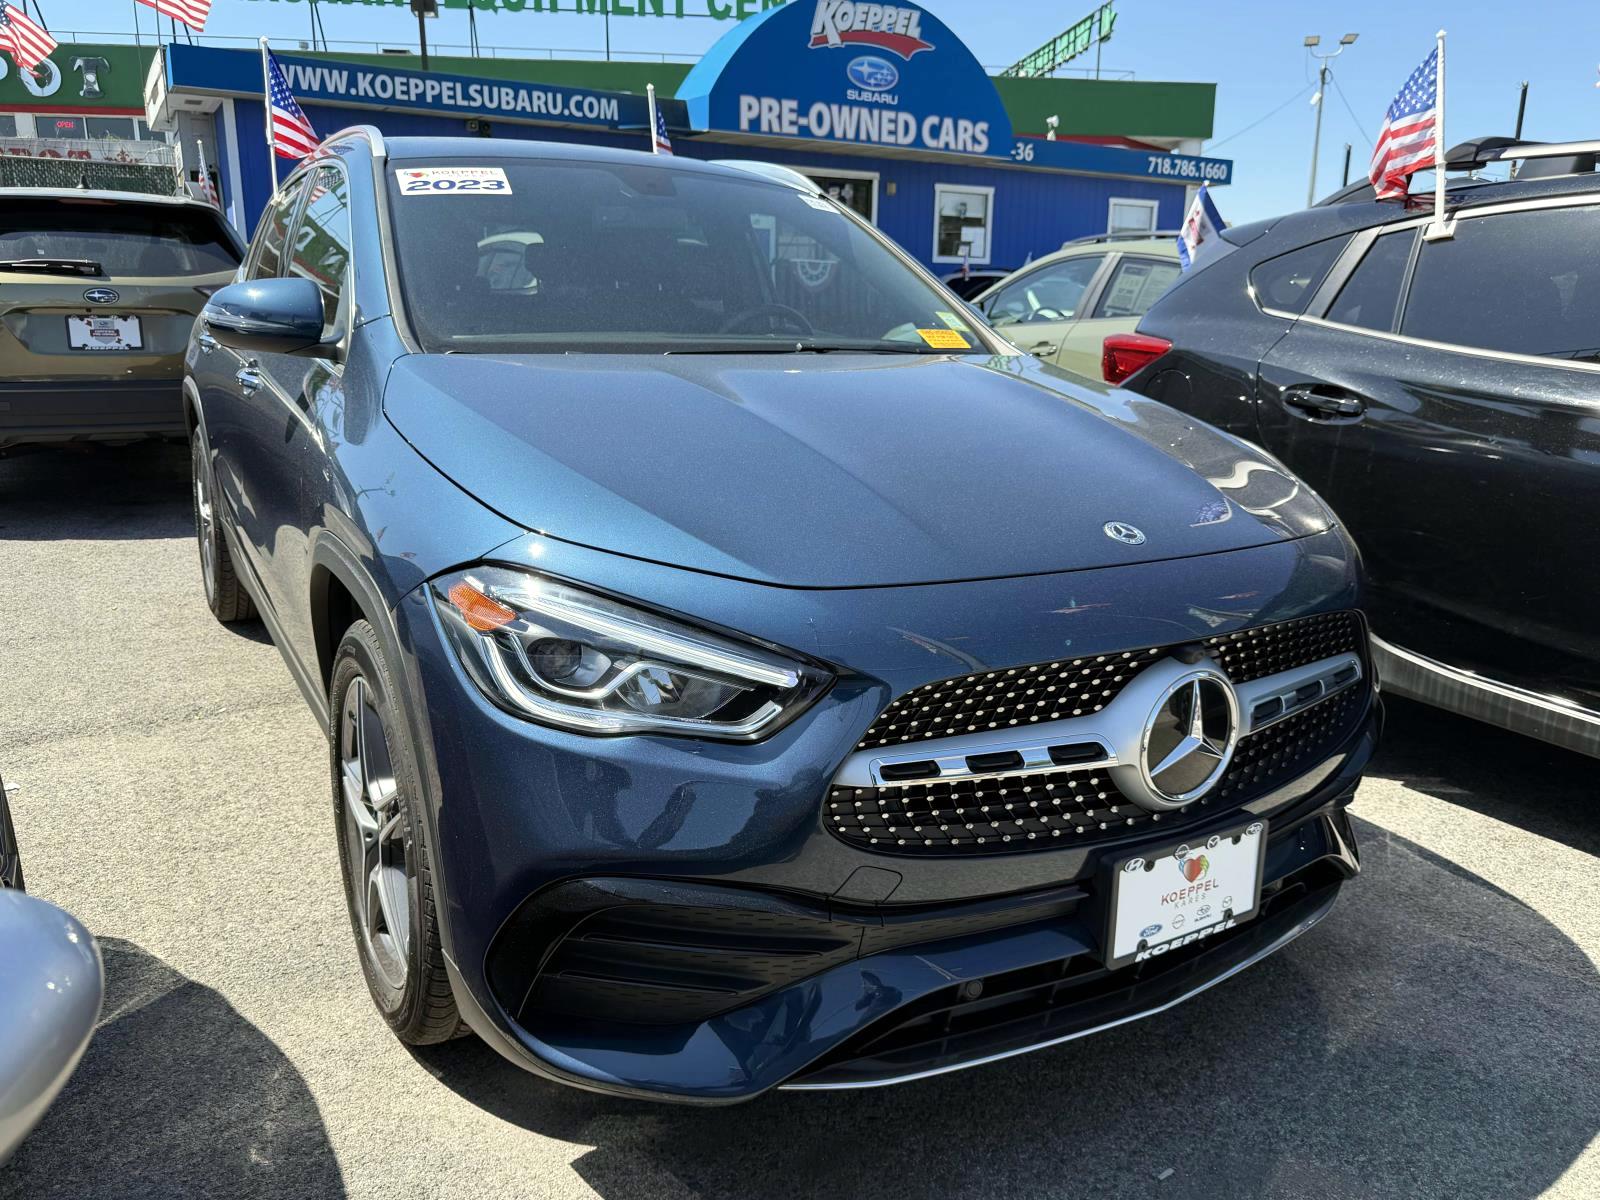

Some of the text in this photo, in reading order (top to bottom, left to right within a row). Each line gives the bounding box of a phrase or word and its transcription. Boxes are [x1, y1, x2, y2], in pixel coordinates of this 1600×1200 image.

[810, 0, 921, 47] KOEPPEL
[0, 55, 111, 98] OT
[279, 63, 619, 121] WWW.KOEPPELSUBARU.COM
[846, 89, 899, 105] SUBARU
[739, 94, 990, 153] PRE-OWNED CARS
[405, 179, 505, 192] 2023
[1147, 156, 1228, 181] 718.786.1660
[1160, 878, 1219, 906] KOEPPEL
[1134, 919, 1236, 963] KOEPPEL
